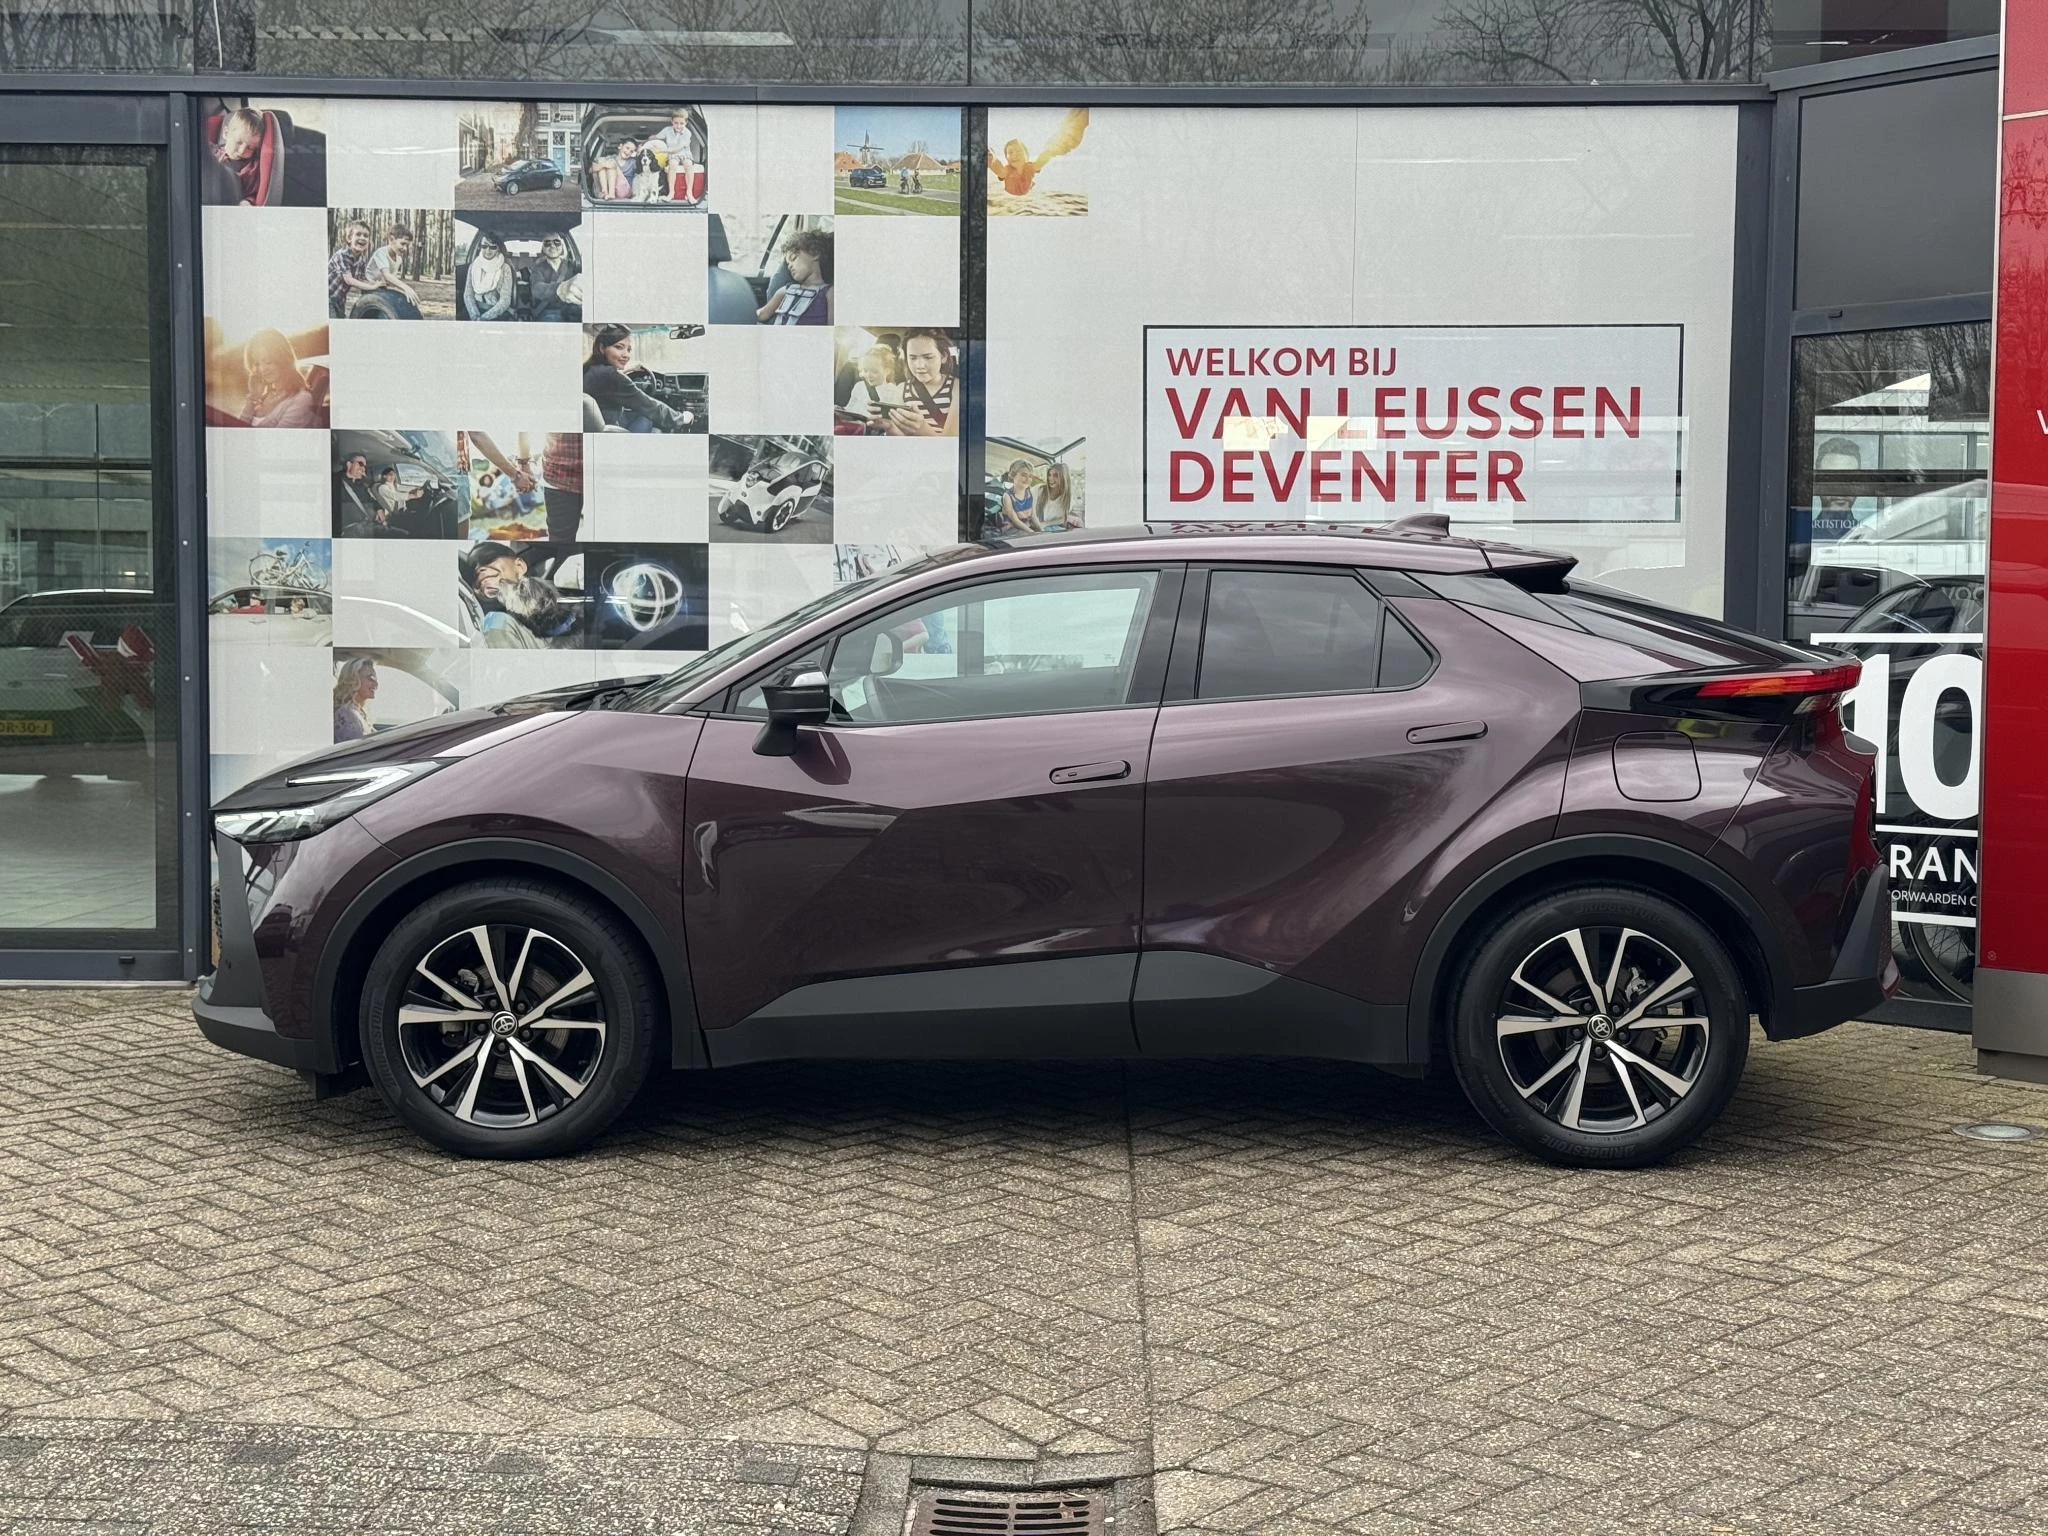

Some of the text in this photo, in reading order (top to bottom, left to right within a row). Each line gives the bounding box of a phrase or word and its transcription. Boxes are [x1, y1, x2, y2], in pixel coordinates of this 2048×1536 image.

[1165, 347, 1398, 377] WELKOM BIJ
[1165, 386, 1642, 441] VAN LEUSSEN
[1169, 450, 1527, 503] DEVENTER
